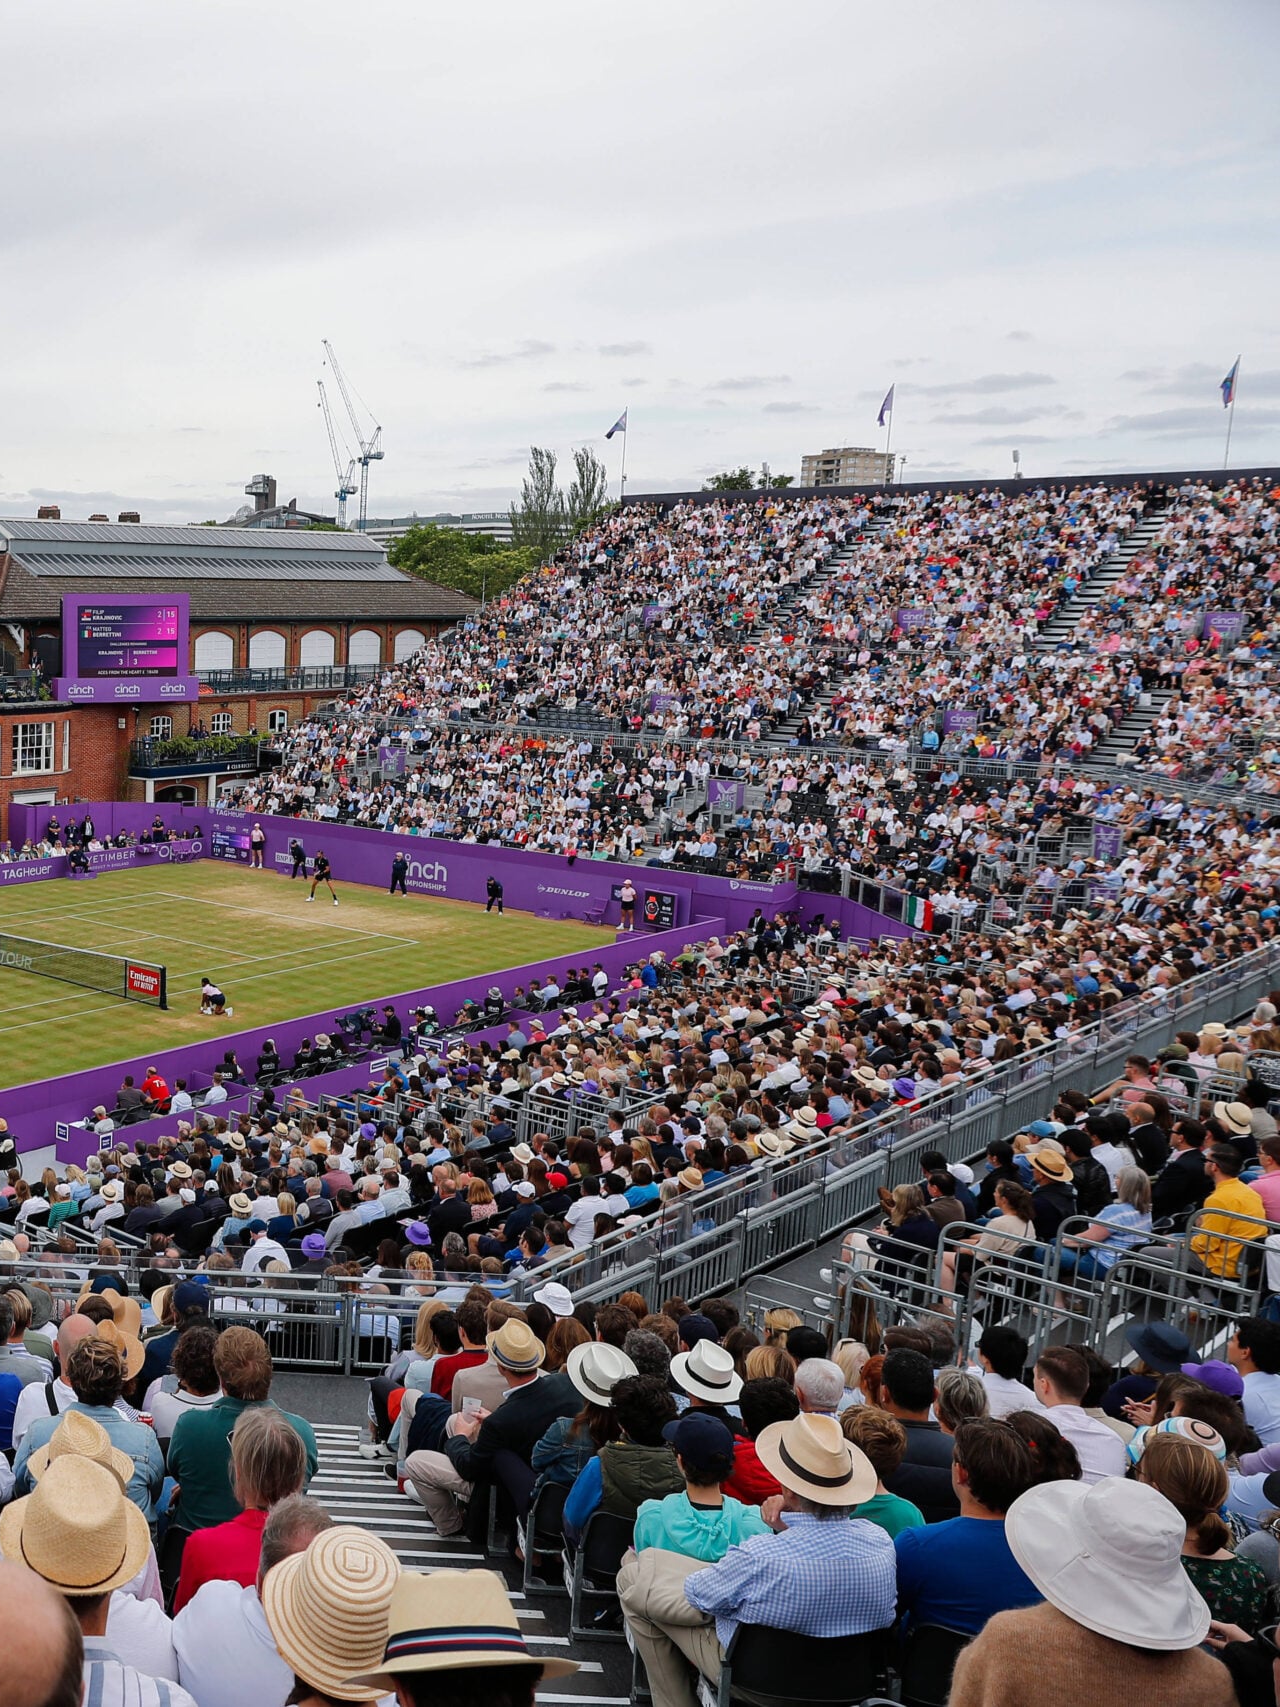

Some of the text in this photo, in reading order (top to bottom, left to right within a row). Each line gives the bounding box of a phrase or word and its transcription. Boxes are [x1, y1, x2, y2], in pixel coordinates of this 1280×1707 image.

[68, 684, 94, 694] cinch
[115, 683, 140, 694] cinch
[160, 682, 185, 693] cinch
[86, 850, 136, 864] YETIMBER
[404, 854, 447, 882] inch
[404, 880, 446, 892] AMPIONSHIPS
[545, 886, 590, 898] DUNLOP
[130, 970, 158, 984] Emirates
